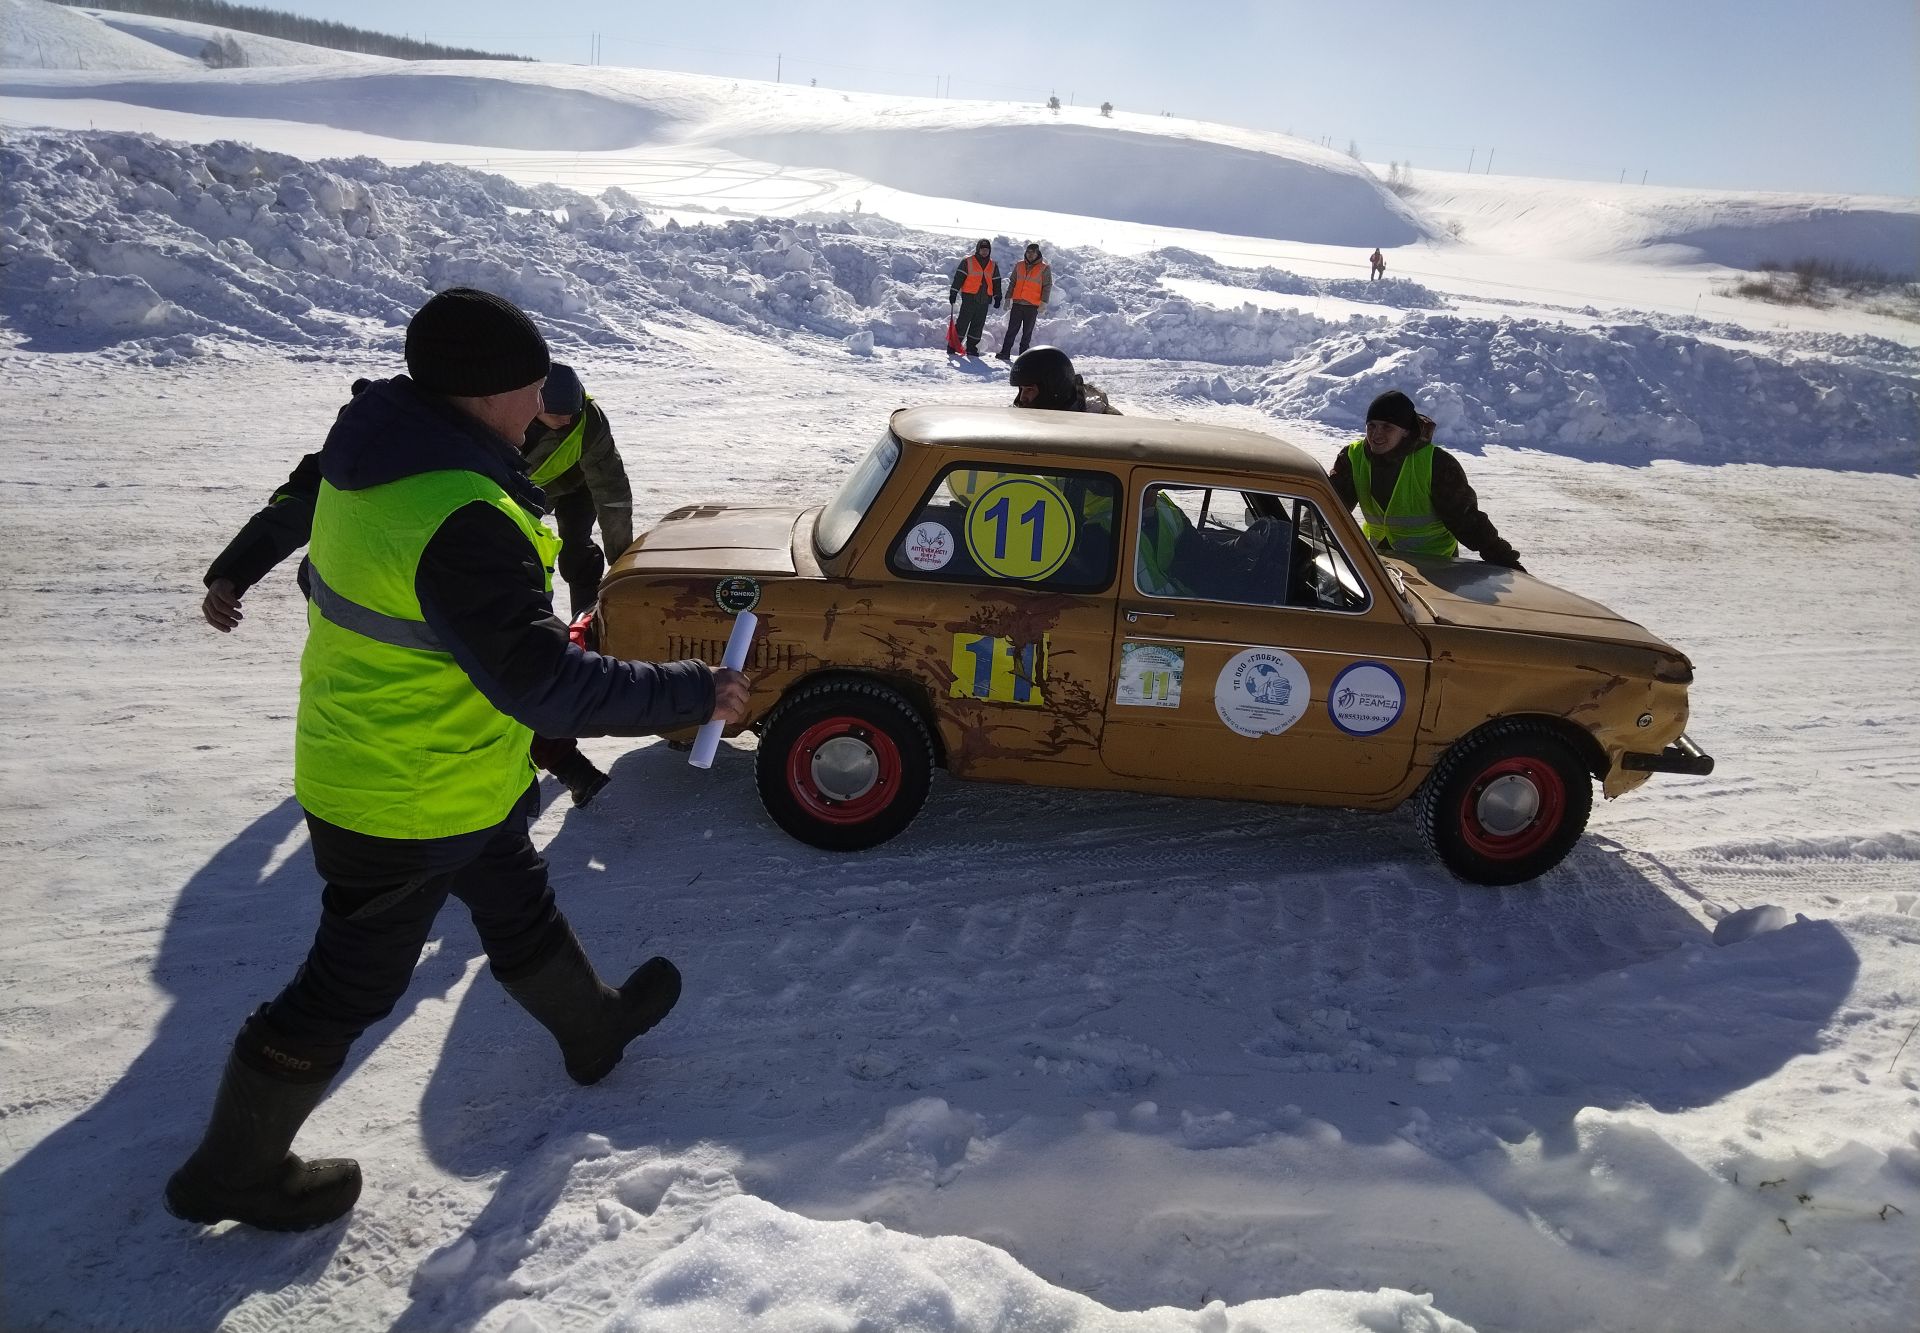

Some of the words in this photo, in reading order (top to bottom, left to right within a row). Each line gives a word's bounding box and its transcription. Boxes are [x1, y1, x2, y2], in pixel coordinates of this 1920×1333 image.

[984, 497, 1046, 562] 11
[965, 636, 1035, 702] 11
[1138, 670, 1171, 701] 11
[1359, 698, 1398, 710] РЕАМЕД
[262, 1045, 312, 1071] NORD
